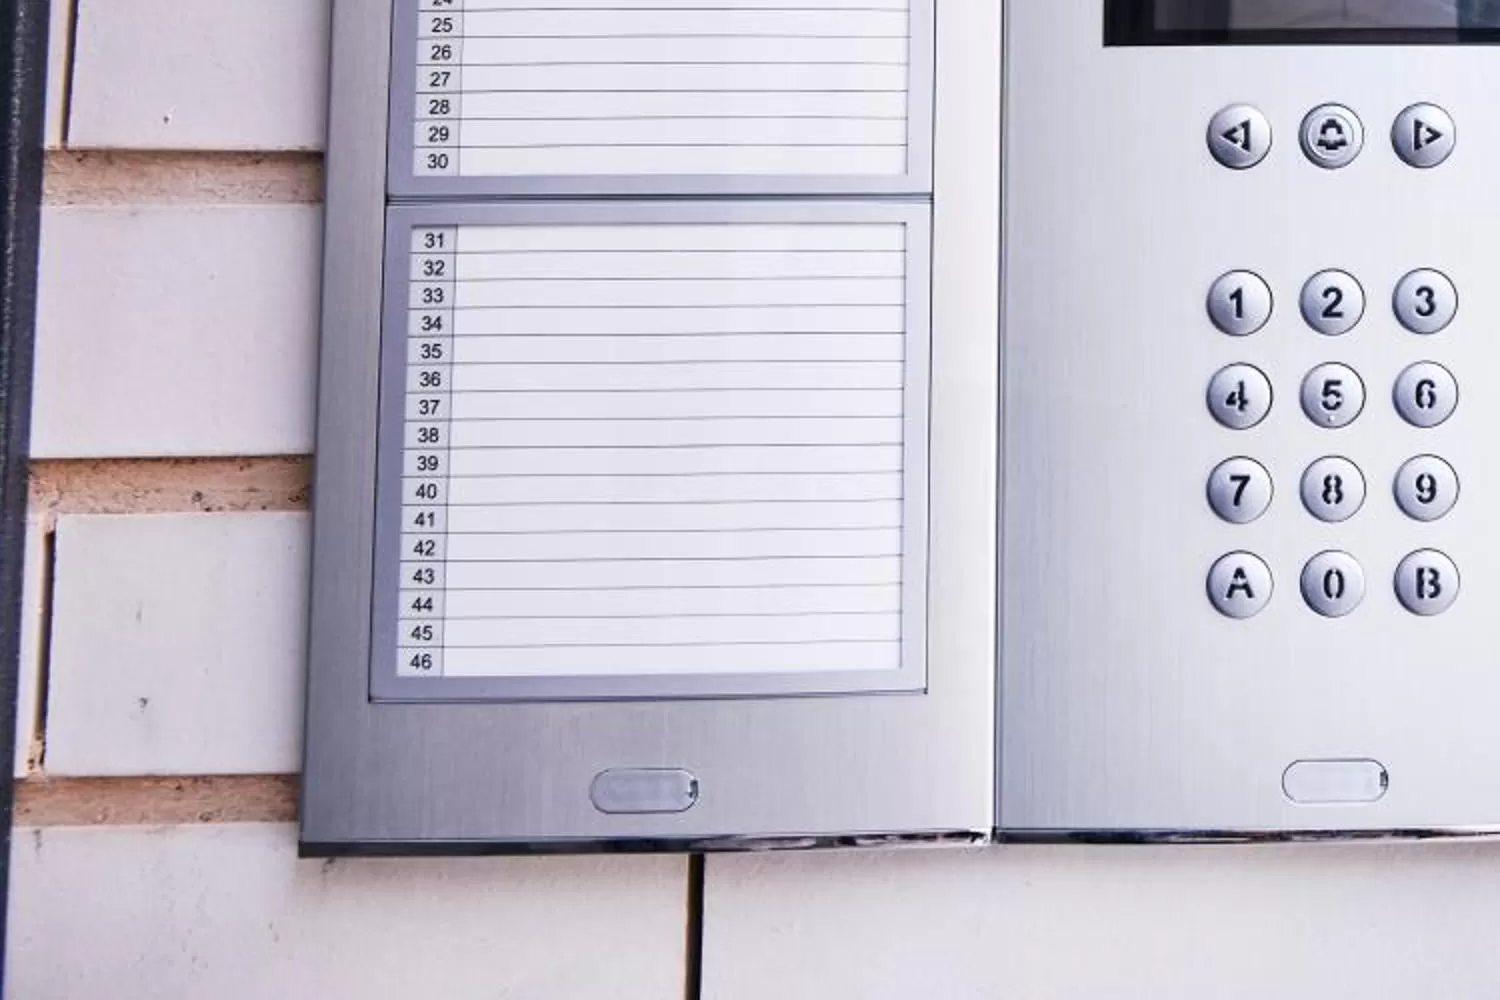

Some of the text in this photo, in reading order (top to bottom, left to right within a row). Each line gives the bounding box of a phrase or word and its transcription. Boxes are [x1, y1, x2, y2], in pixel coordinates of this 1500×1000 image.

[431, 17, 454, 33] 25
[430, 43, 453, 61] 26
[429, 71, 452, 88] 27
[428, 98, 451, 116] 28
[427, 125, 450, 143] 29
[427, 153, 449, 169] 30
[424, 232, 444, 249] 31
[423, 258, 446, 277] 32
[422, 287, 445, 304] 33
[1228, 286, 1436, 319] 1 2 3
[420, 315, 443, 332] 34
[420, 343, 443, 360] 35
[419, 370, 442, 388] 36
[1224, 379, 1437, 413] 4 5 6
[418, 398, 441, 416] 37
[417, 426, 440, 444] 38
[416, 455, 440, 472] 39
[415, 483, 438, 500] 40
[1229, 473, 1438, 507] 7 8 9
[413, 511, 435, 528] 41
[413, 539, 436, 557] 42
[411, 567, 436, 585] 43
[1225, 567, 1441, 600] A 0 B
[410, 596, 434, 613] 44
[410, 624, 433, 642] 45
[409, 653, 433, 670] 46
